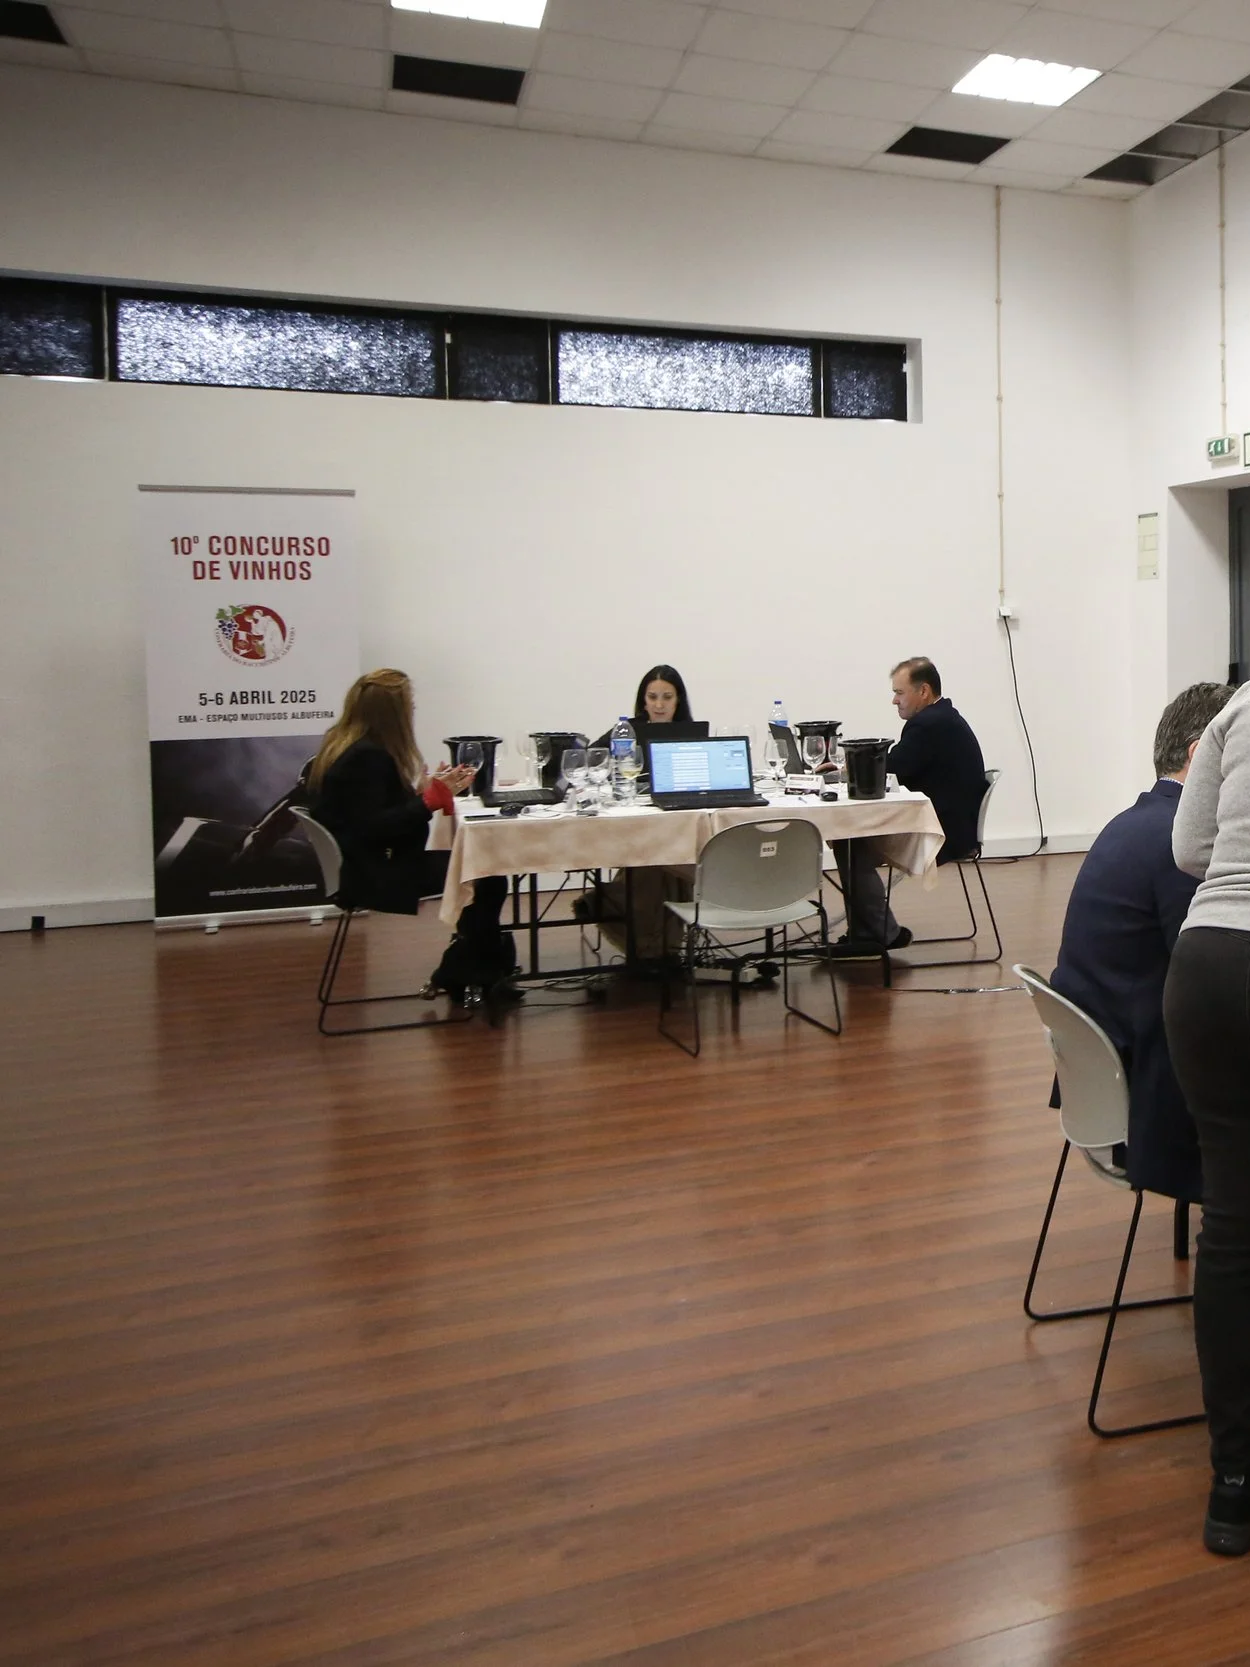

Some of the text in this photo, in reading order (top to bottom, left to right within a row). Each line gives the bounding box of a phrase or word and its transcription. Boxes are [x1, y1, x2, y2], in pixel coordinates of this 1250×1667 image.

[208, 535, 331, 557] CONCURSO
[193, 560, 312, 581] DE VINHOS
[199, 689, 317, 706] 5-6 ABRIL 2025
[178, 714, 198, 723] EMA
[206, 713, 239, 723] ESPAÇO
[241, 711, 289, 721] MULTIUSOS
[290, 710, 335, 720] ALBUFEIRA
